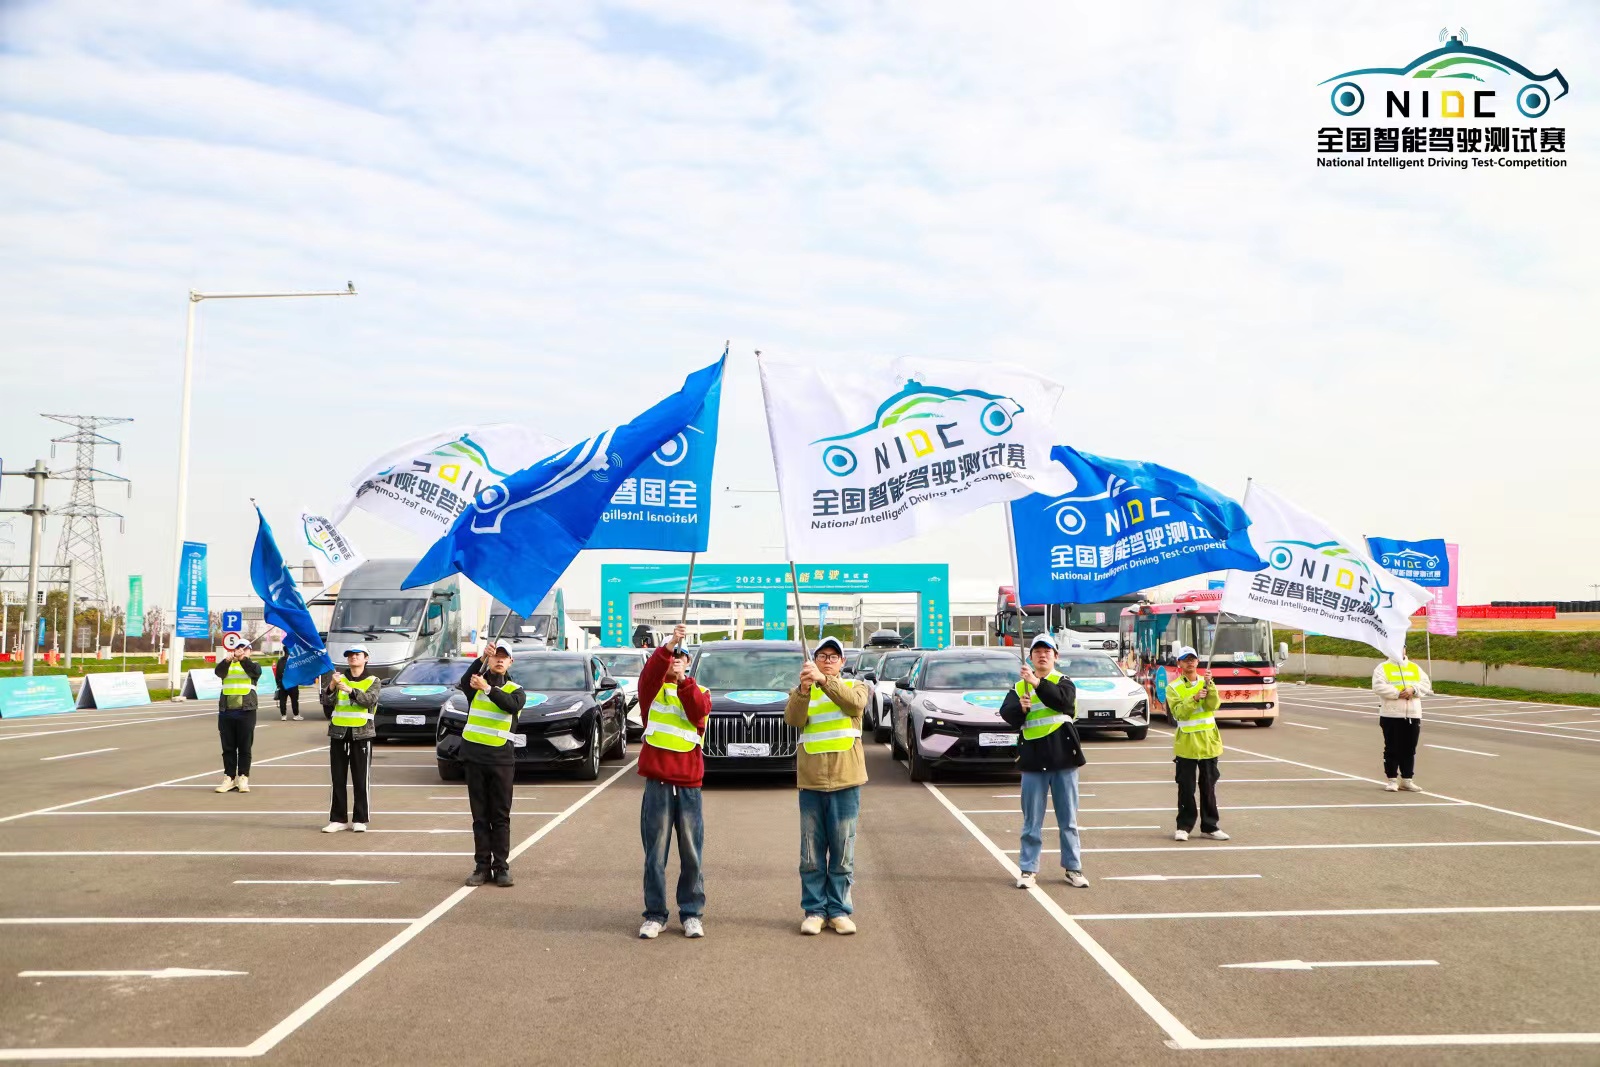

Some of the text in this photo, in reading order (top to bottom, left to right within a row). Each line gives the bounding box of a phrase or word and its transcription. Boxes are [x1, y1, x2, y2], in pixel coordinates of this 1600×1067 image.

[874, 421, 965, 475] NIDC
[812, 442, 1027, 517] 全国智能驾驶测试赛
[811, 518, 858, 530] National
[860, 502, 909, 525] Intelligent
[909, 490, 947, 506] Driving
[1105, 497, 1170, 537] NIDC
[1051, 572, 1092, 581] National
[1093, 563, 1129, 581] Intelligent
[1129, 555, 1160, 569] Driving
[1394, 559, 1422, 569] NIDC
[1248, 592, 1279, 607] National
[1280, 600, 1319, 615] Intelligent
[1319, 609, 1345, 623] Driving
[1251, 573, 1383, 624] 全国智能驾驶测
[227, 615, 238, 629] P
[229, 636, 235, 646] 5
